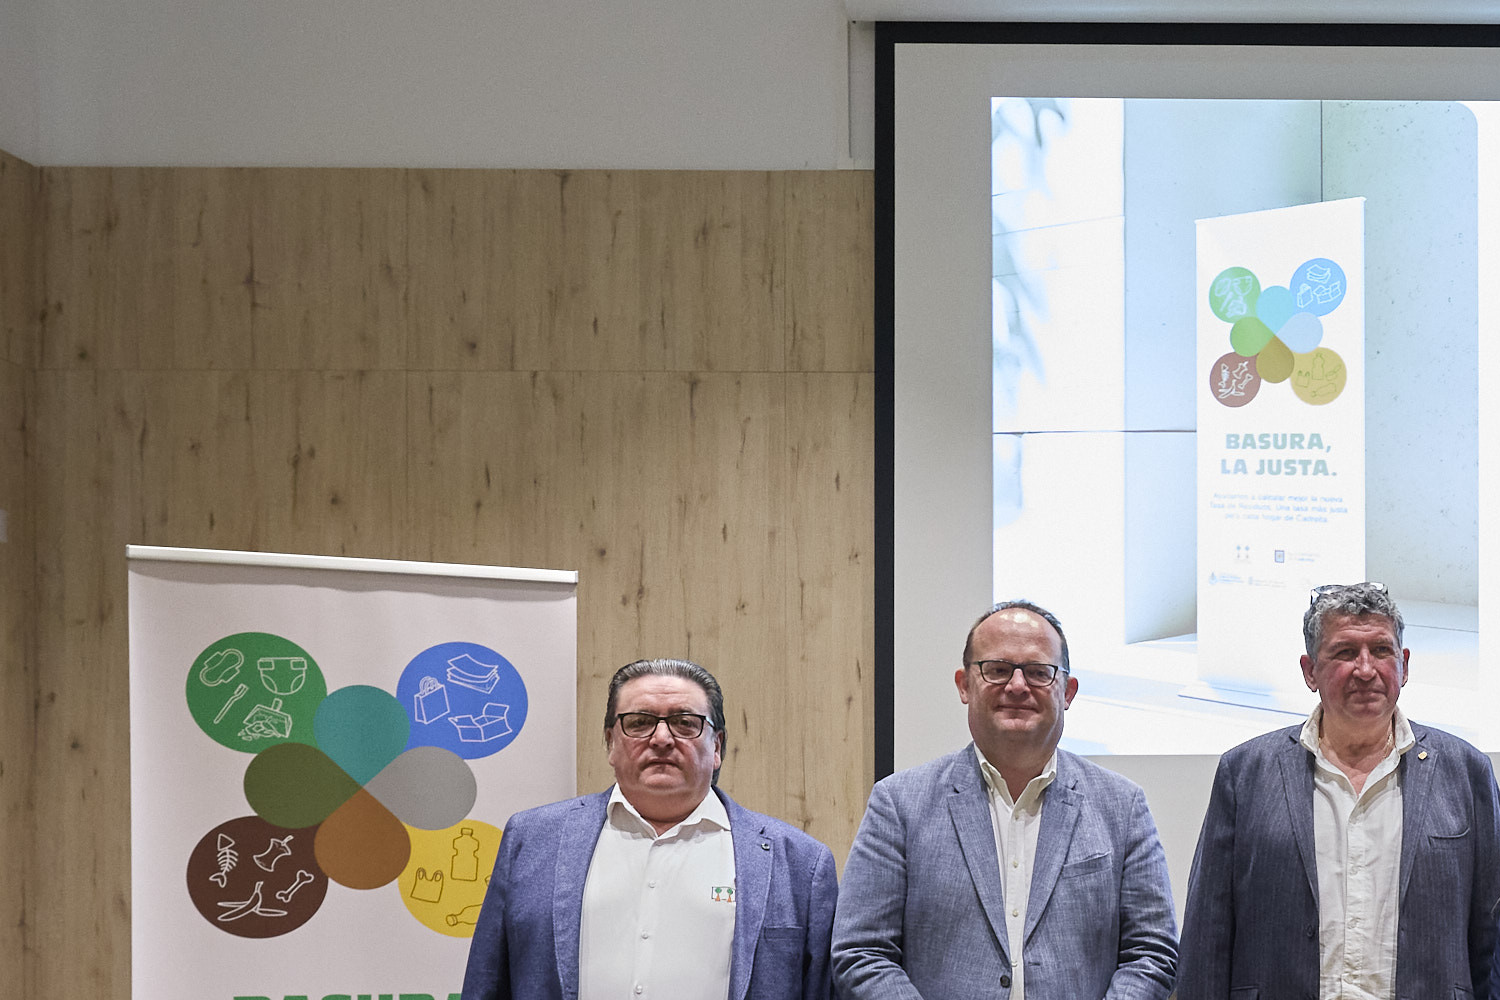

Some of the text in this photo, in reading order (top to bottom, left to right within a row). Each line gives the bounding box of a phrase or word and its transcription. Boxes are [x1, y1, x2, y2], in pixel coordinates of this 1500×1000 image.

[1226, 433, 1332, 452] BASURA,
[1220, 459, 1337, 476] LA JUSTA.
